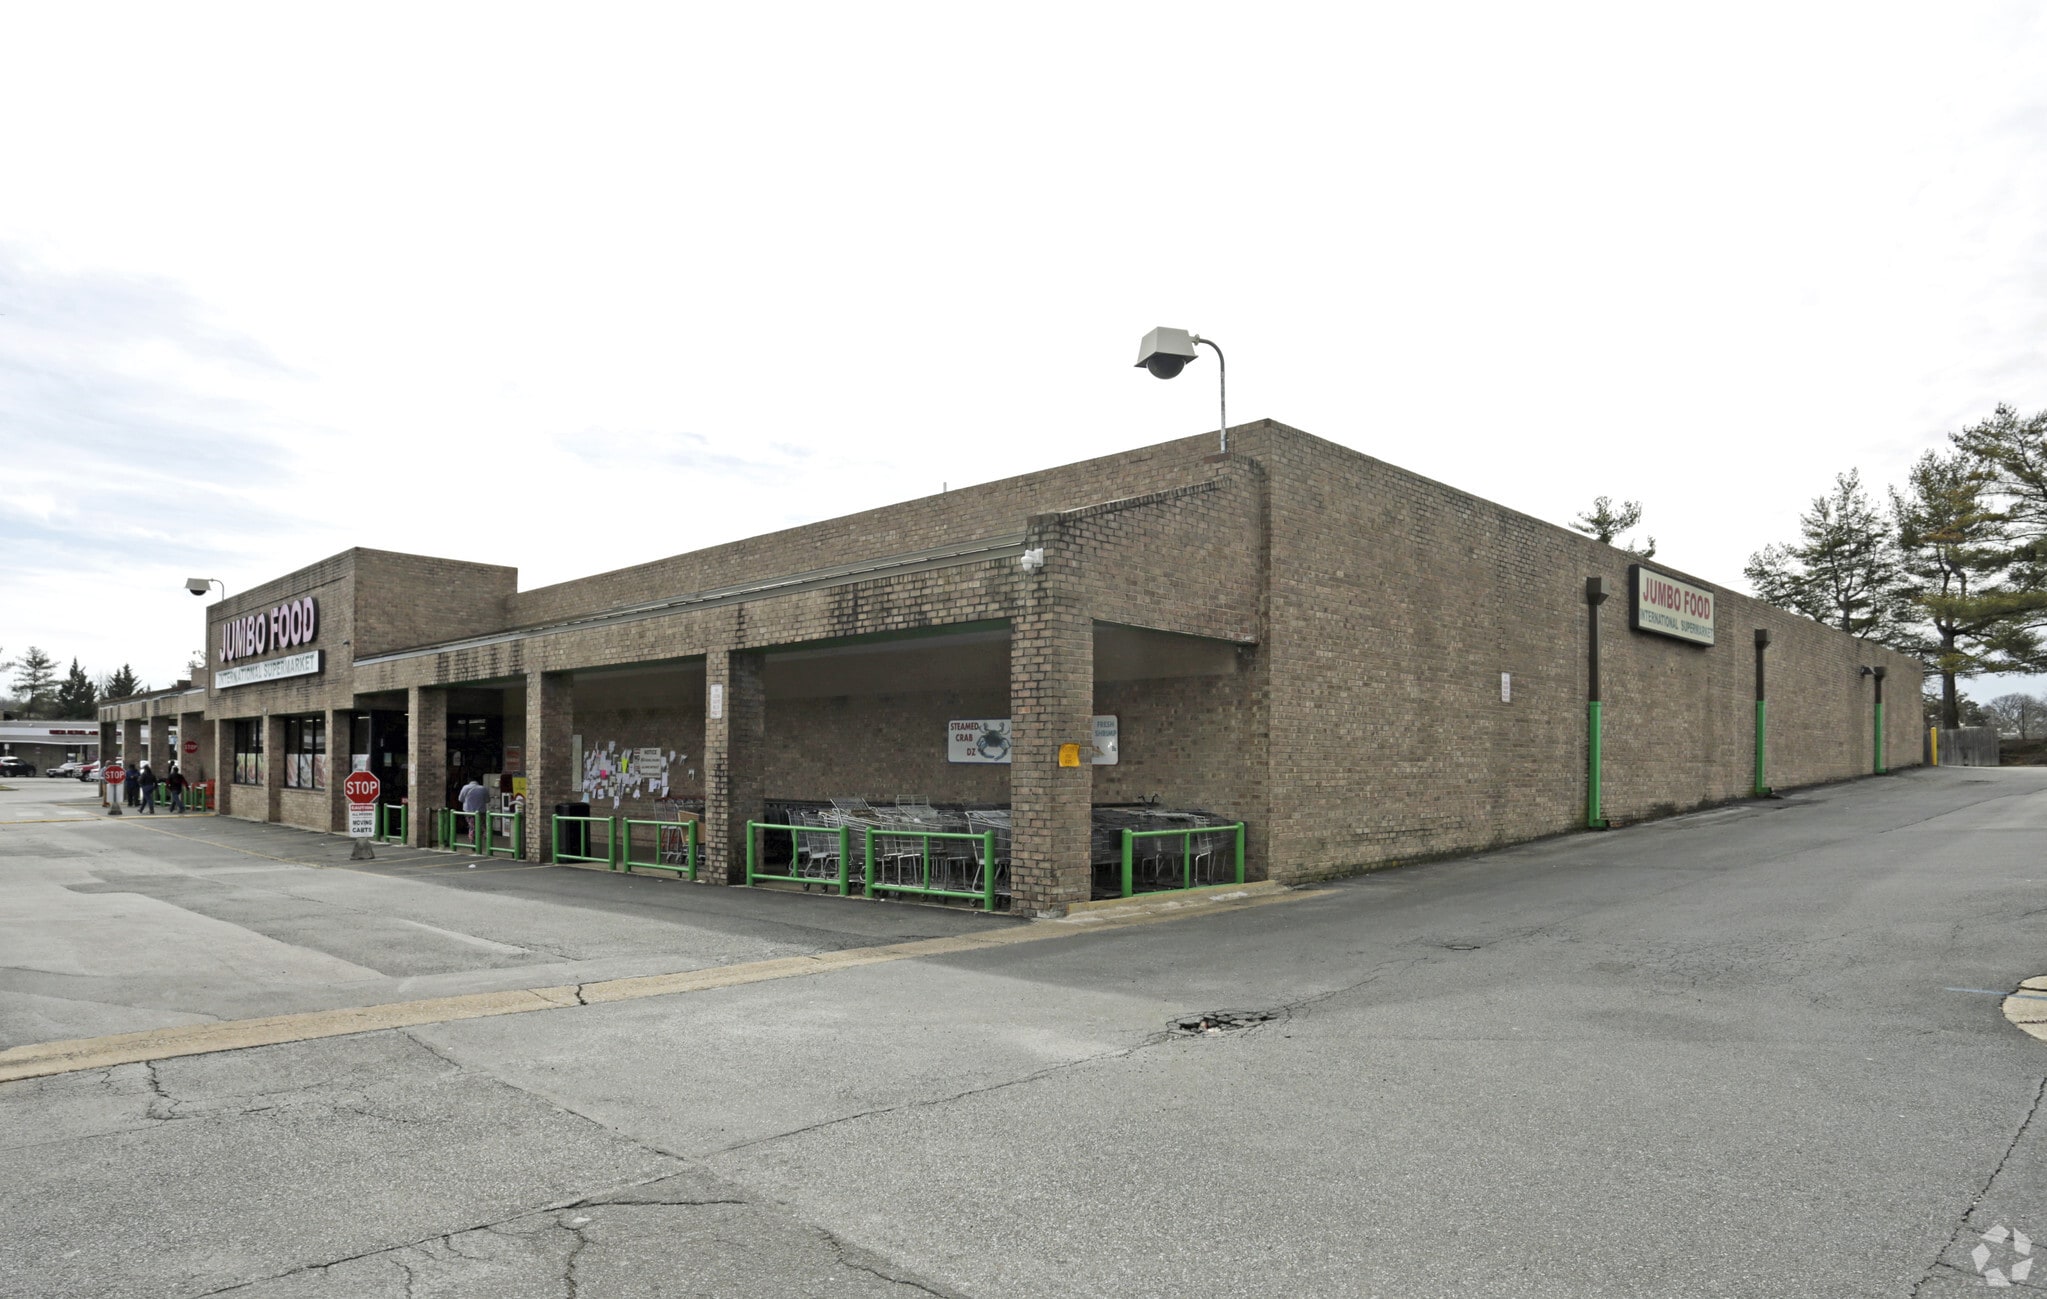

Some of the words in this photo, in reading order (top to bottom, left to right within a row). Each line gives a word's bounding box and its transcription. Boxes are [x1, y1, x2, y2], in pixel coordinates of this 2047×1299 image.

[1643, 577, 1681, 611] JUMBO
[1684, 590, 1710, 620] FOOD
[219, 613, 266, 662] JUMBO
[270, 596, 315, 650] FOOD
[1640, 608, 1678, 630] INTERNATIONAL
[1681, 620, 1713, 638] SUPERMARKET
[218, 665, 261, 684] INTERNATIONAL
[263, 654, 315, 679] SUPERMARKET
[950, 722, 979, 731] STEAMED
[955, 733, 973, 742] CRAB
[966, 747, 976, 757] DZ
[105, 771, 125, 779] STOP
[346, 781, 378, 795] STOP
